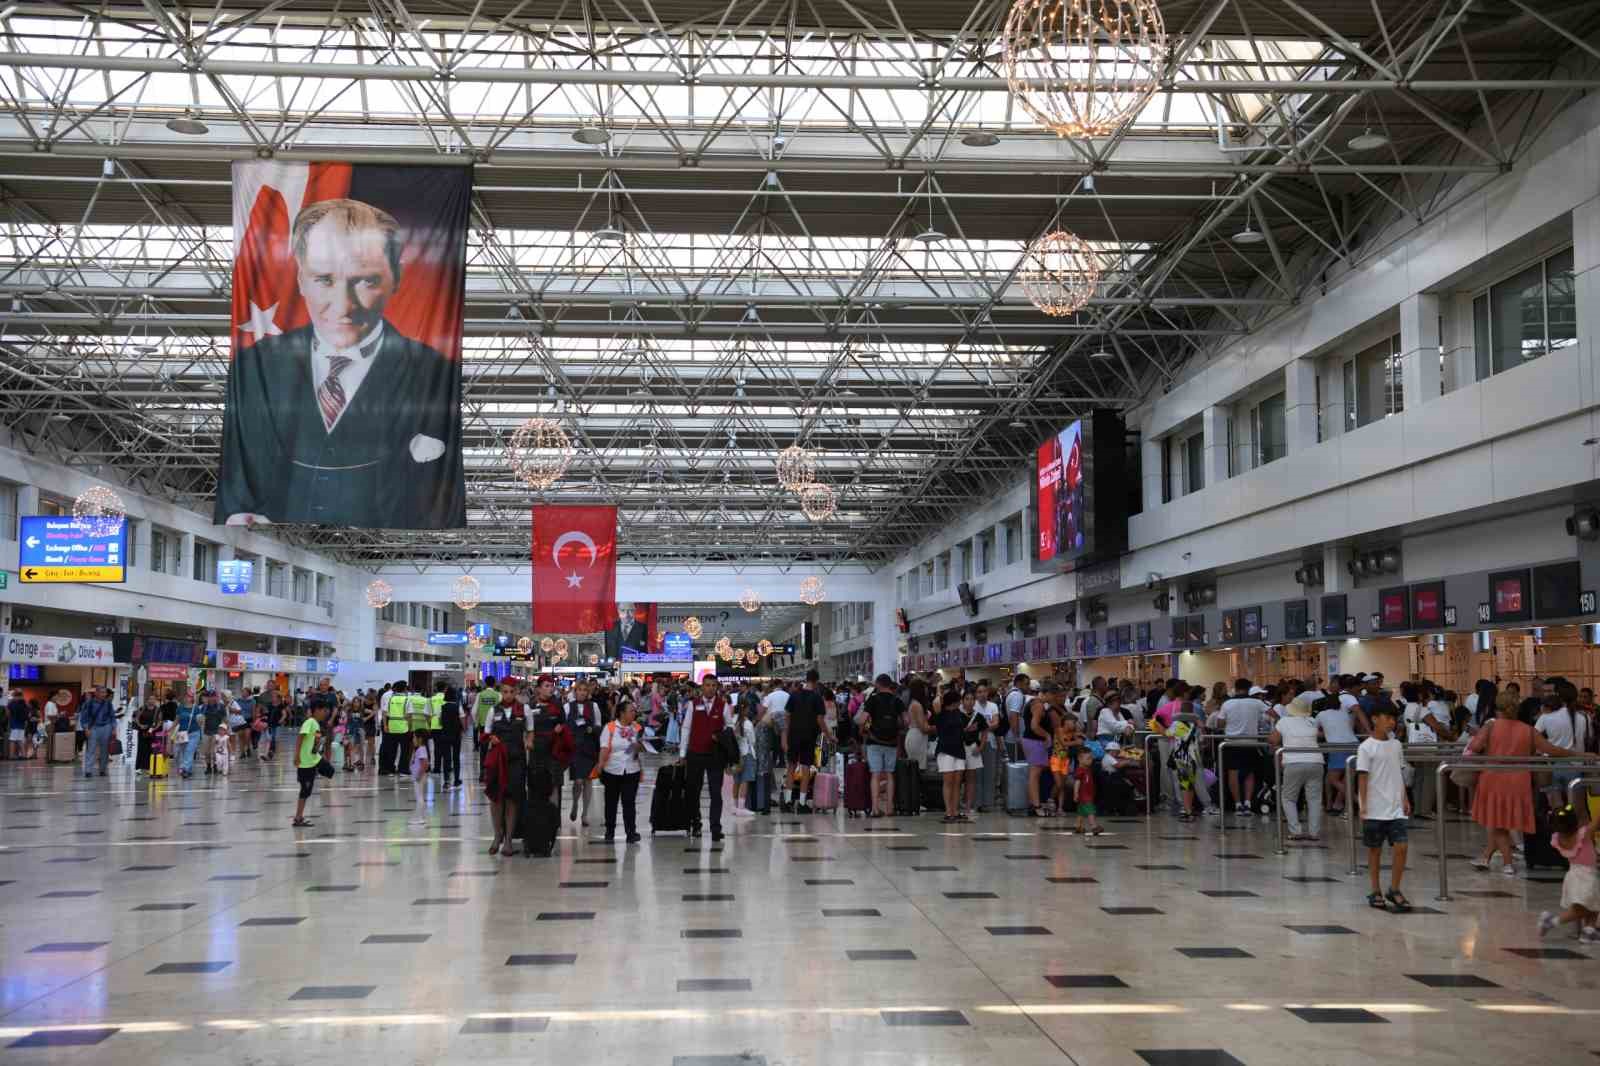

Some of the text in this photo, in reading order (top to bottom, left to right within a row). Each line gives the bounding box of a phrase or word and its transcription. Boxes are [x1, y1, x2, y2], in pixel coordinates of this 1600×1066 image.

[1580, 593, 1595, 612] 150
[1479, 604, 1490, 622] 149
[9, 638, 39, 658] Change
